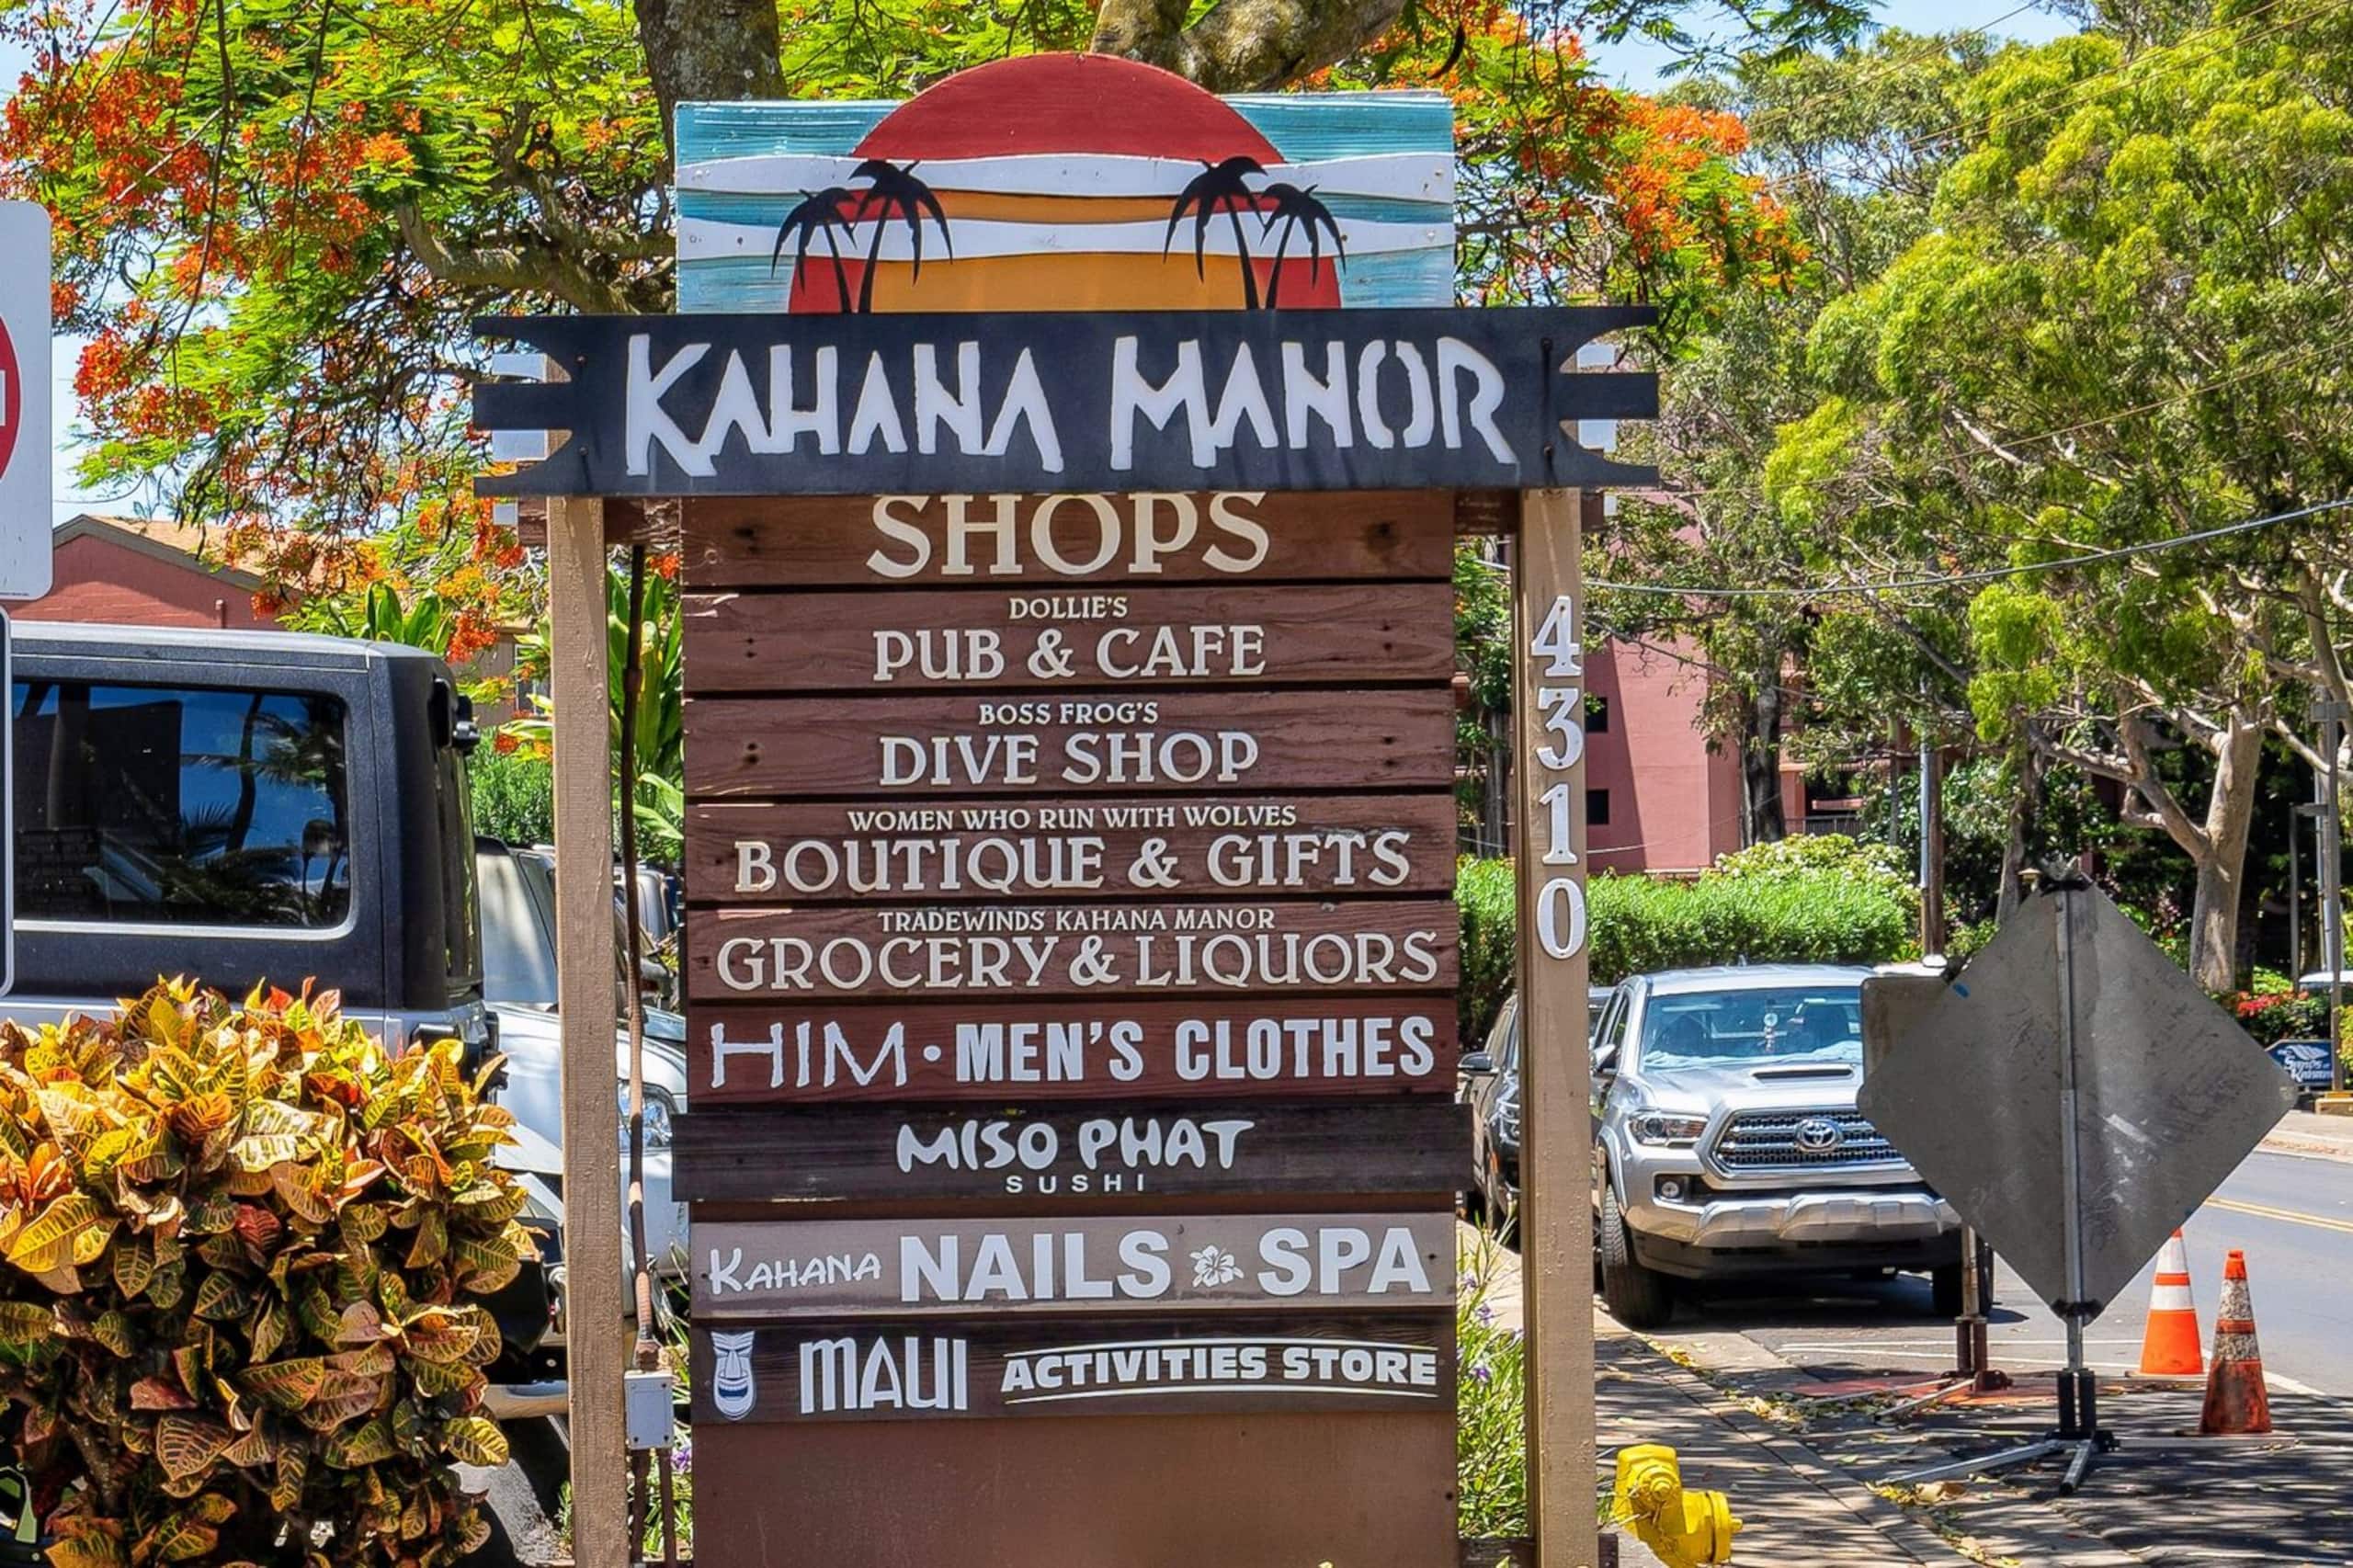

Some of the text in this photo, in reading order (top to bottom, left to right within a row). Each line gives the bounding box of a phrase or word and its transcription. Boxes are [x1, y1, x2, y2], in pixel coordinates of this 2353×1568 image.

[626, 333, 1518, 477] KAHANA MANOR
[866, 491, 1270, 578] SHOPS
[1008, 597, 1129, 619] DOLLIE'S
[871, 624, 1267, 682] PUB & CAFE
[978, 701, 1160, 726] BOSS FROG'S
[879, 732, 1259, 788] DIVE SHOP
[1530, 595, 1588, 961] 4310
[847, 804, 1298, 832] WOMEN WHO RUN WITH WOLVES
[734, 831, 1412, 895] BOUTIQUE & GIFTS
[878, 907, 1276, 933] TRADEWINDS KAHANA MANOR
[716, 930, 1438, 992] GROCERY & LIQUORS
[710, 1016, 1435, 1089] HIM MEN'S CLOTHES
[896, 1117, 1256, 1174] MISO PHAT
[1006, 1174, 1145, 1194] SUSHI
[708, 1227, 1433, 1301] KAHANA NAILS SPA
[800, 1335, 1437, 1415] MAUI ACTIVITIES STORE
